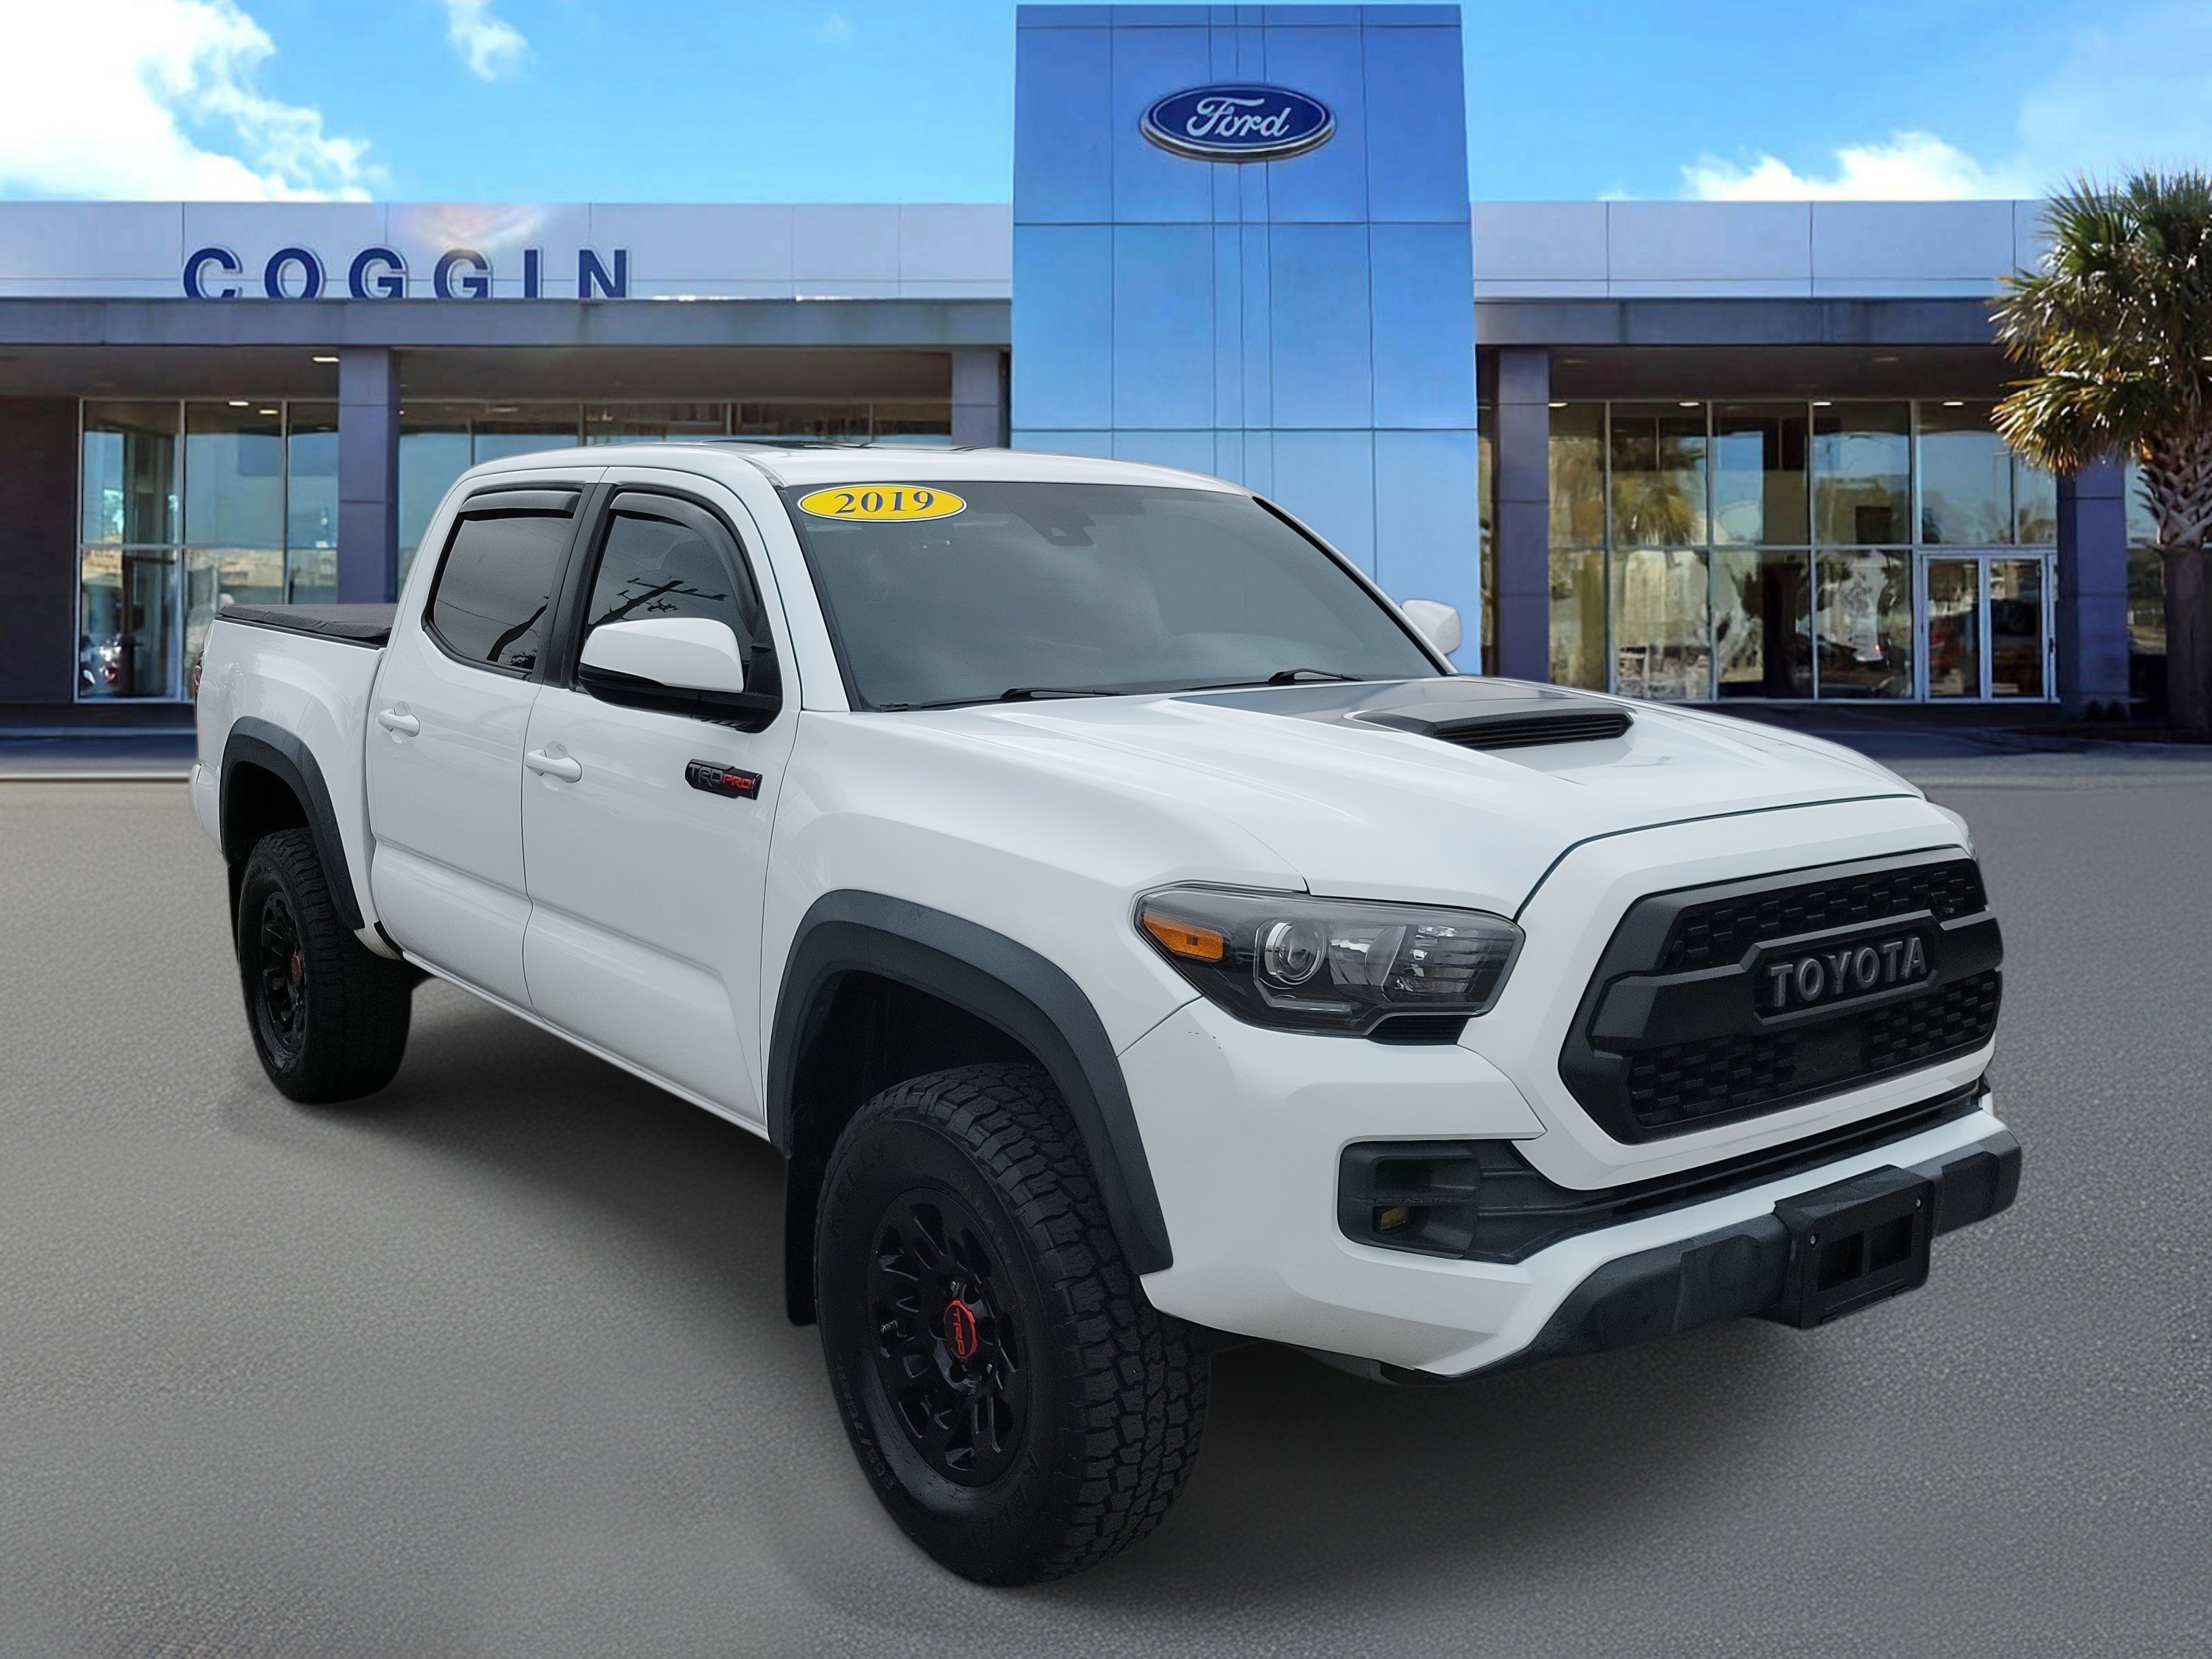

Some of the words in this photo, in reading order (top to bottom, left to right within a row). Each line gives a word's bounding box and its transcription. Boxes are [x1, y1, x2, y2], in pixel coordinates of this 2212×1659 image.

[1186, 96, 1292, 137] Ford
[182, 246, 630, 299] COGGIN
[834, 490, 935, 515] 2019
[688, 763, 724, 787] TRD
[722, 773, 753, 791] PRO
[1769, 936, 1927, 1008] TOYOTA
